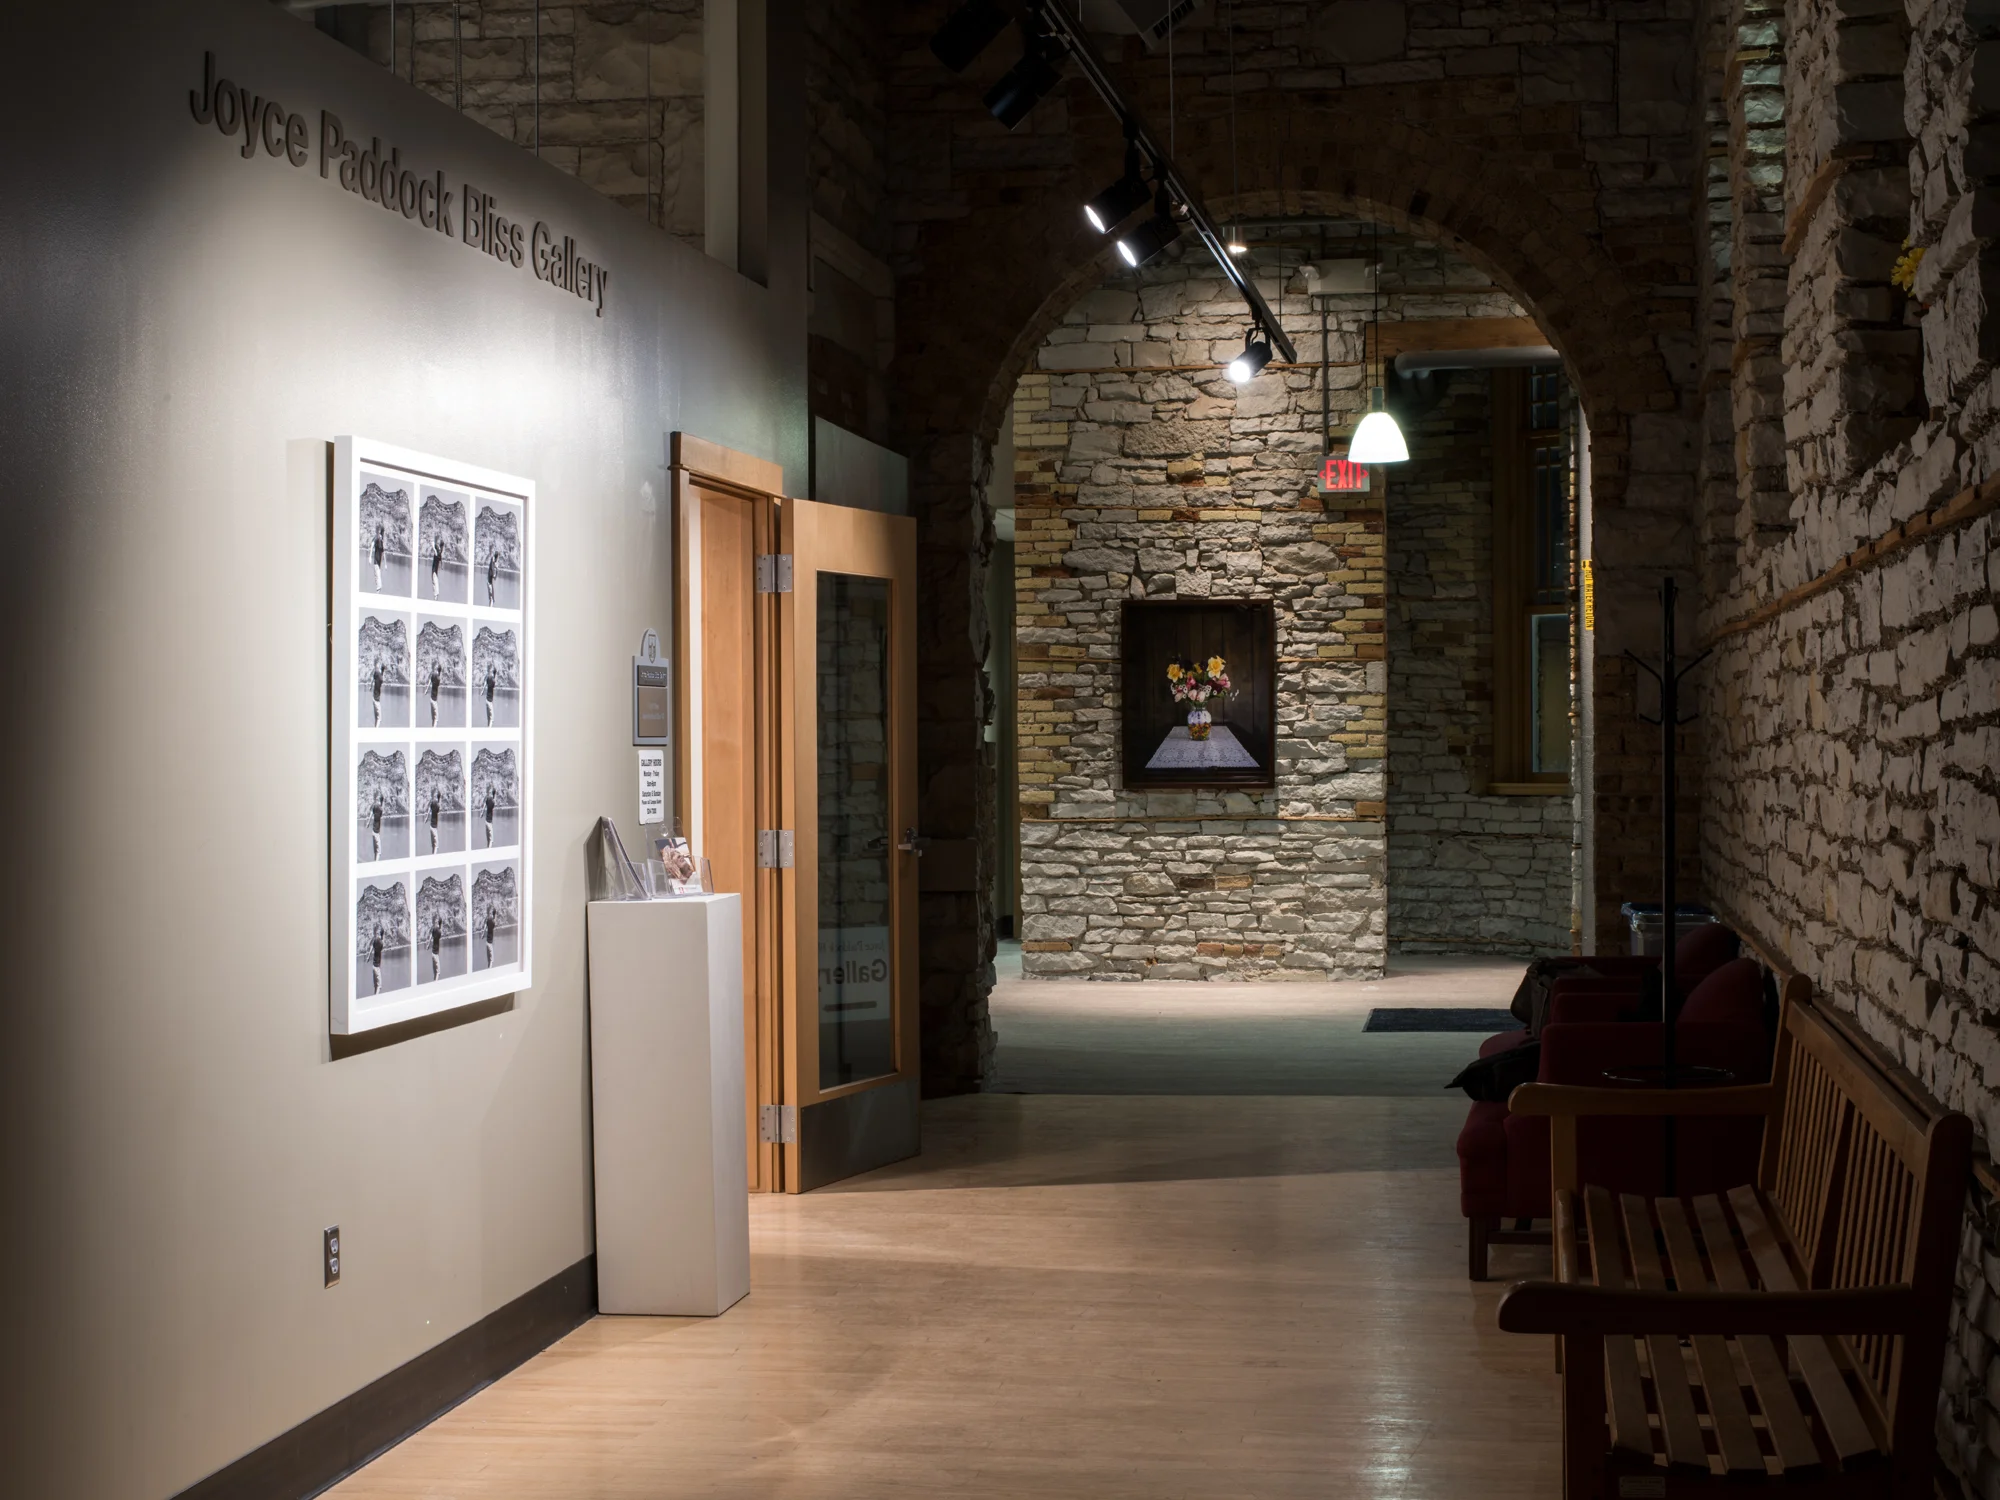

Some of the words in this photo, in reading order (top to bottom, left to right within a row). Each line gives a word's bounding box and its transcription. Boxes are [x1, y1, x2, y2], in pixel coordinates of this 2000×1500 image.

[190, 51, 309, 168] Joyce
[319, 109, 454, 239] Paddock
[462, 184, 525, 269] Bliss
[531, 221, 608, 318] Gallery
